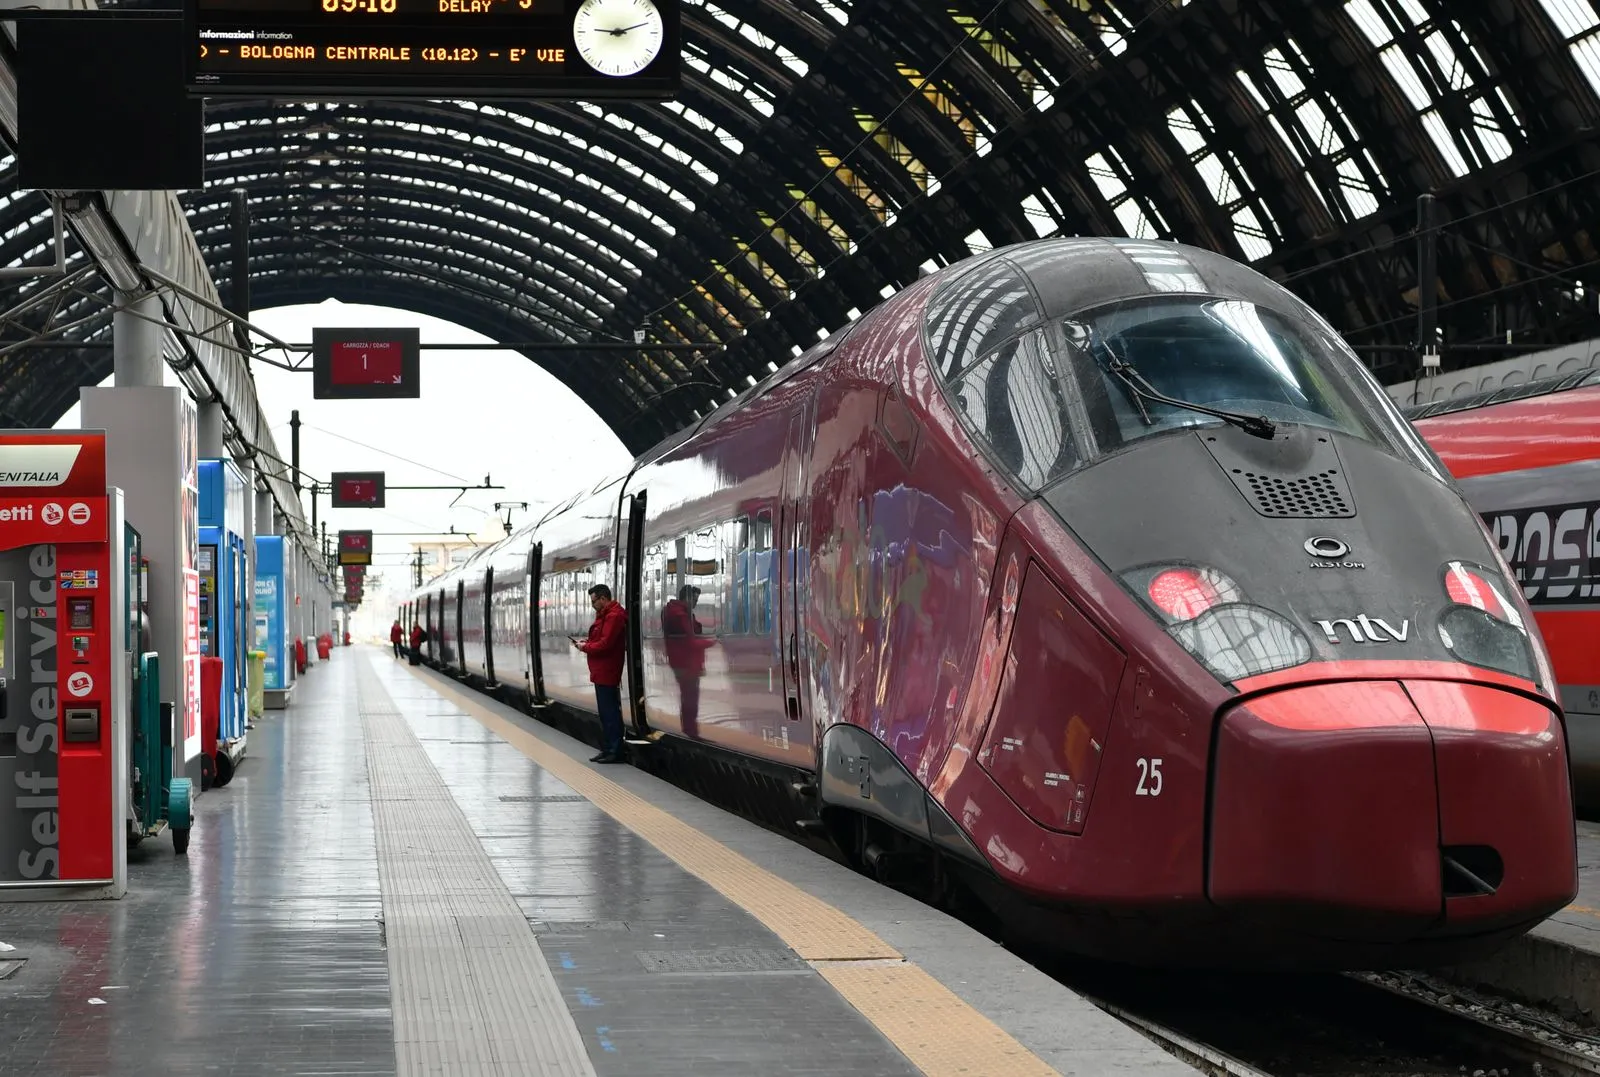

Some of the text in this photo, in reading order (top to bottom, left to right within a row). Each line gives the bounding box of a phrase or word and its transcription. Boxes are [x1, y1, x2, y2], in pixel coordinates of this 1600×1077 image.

[439, 0, 491, 12] DELAY
[199, 30, 293, 39] informazioni information
[240, 46, 315, 58] BOLOGNA
[326, 46, 410, 60] CENTRALE
[421, 48, 478, 61] (10.12)
[537, 49, 565, 62] VIE
[361, 353, 367, 370] 1
[0, 472, 59, 481] ENITALIA
[355, 485, 360, 495] 2
[0, 504, 33, 521] etti
[1309, 561, 1365, 569] ALSTOM
[1312, 613, 1409, 644] ntv
[16, 545, 57, 754] Service
[1135, 757, 1163, 797] 25
[15, 771, 58, 880] Self
